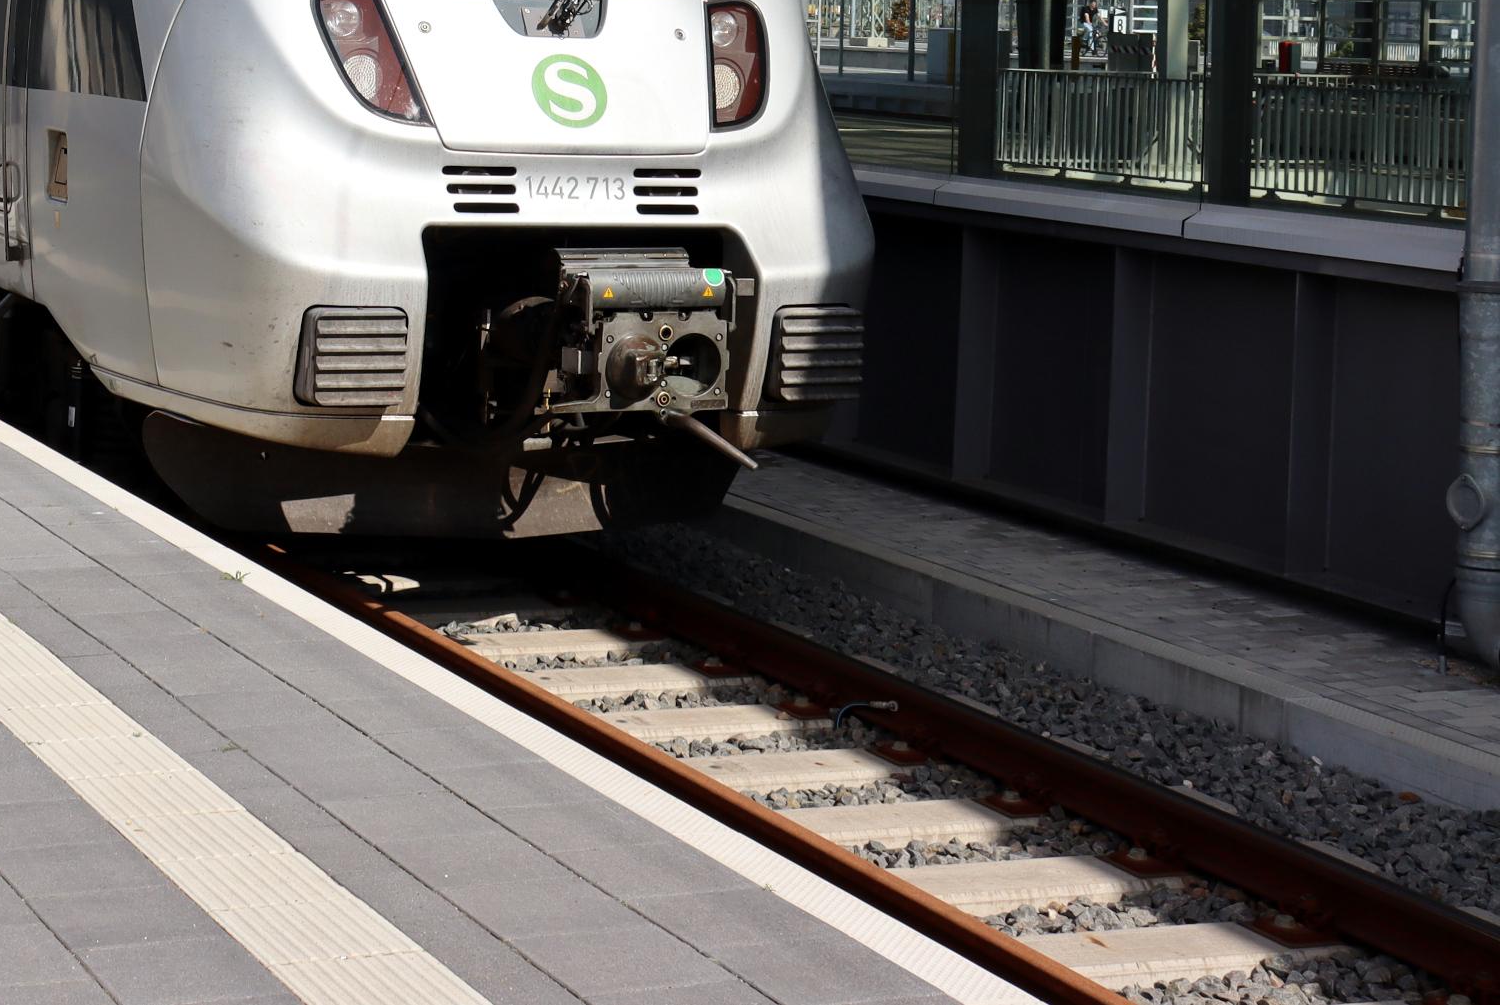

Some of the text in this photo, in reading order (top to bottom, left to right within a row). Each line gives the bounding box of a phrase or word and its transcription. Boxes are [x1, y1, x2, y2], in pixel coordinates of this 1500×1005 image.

[1117, 18, 1124, 33] 8
[544, 61, 597, 120] S
[525, 176, 626, 200] 1442 713
